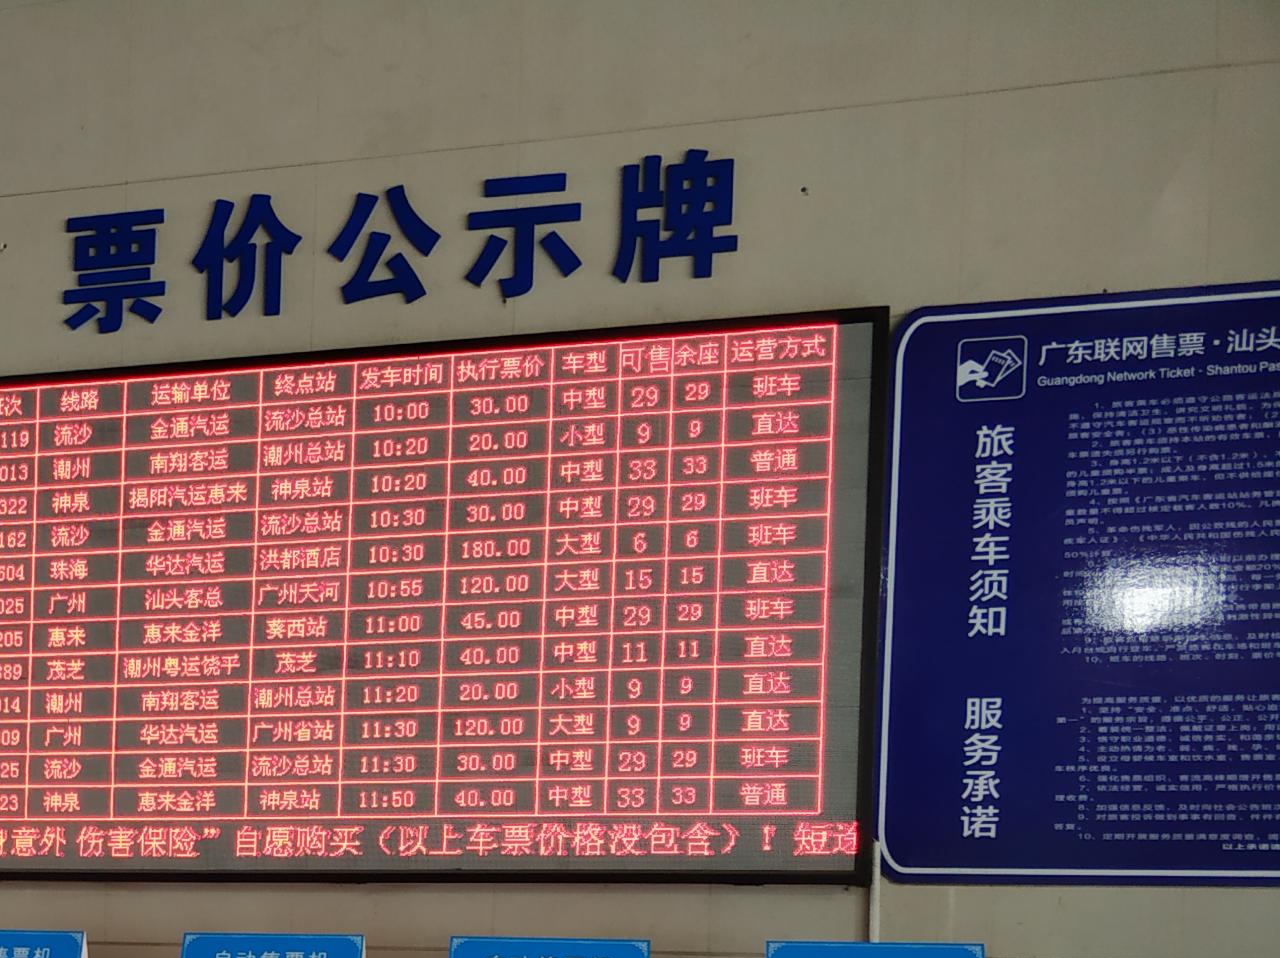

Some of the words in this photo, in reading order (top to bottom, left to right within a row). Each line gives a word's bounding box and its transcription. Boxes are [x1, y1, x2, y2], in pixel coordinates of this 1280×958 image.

[63, 148, 738, 334] 票价公示牌
[61, 388, 99, 412] 线路
[151, 379, 230, 405] 运输单位
[274, 370, 336, 396] 终点站
[359, 363, 442, 389] 发车时间
[456, 355, 544, 382] 执行票价
[562, 350, 607, 374] 车型
[623, 344, 671, 372] 可售
[675, 342, 719, 366] 余座
[731, 334, 826, 363] 运营方式
[1037, 374, 1105, 387] Guangdong
[1107, 369, 1156, 383] Network
[1159, 366, 1196, 379] Ticket
[1206, 363, 1258, 376] Shantou
[54, 423, 92, 446] 流沙
[151, 413, 229, 440] 金通汽运
[264, 405, 346, 431] 流沙总站
[375, 401, 429, 422] 10:00
[471, 395, 528, 415] 30.00
[562, 386, 606, 410] 中型
[632, 385, 659, 408] 29
[685, 382, 710, 401] 29
[753, 373, 801, 398] 班车
[52, 490, 90, 513] 神泉
[129, 481, 247, 508] 揭阳汽运惠来
[272, 476, 333, 500] 神泉站
[372, 473, 427, 493] 10:20
[467, 467, 526, 486] 40.00
[560, 458, 603, 482] 中型
[629, 458, 656, 480] 33
[683, 456, 707, 474] 33
[750, 446, 798, 472] 普通
[50, 558, 88, 580] 珠海
[146, 551, 224, 576] 华达汽运
[260, 546, 341, 570] 洪都酒店
[370, 544, 424, 563] 10:30
[462, 538, 530, 558] 180.00
[556, 532, 601, 555] 大型
[633, 533, 646, 553] 6
[686, 530, 698, 547] 6
[748, 522, 796, 546] 班车
[967, 424, 1016, 638] 旅客乘车须知
[49, 592, 86, 614] 广州
[145, 586, 223, 610] 汕头客总
[258, 581, 340, 605] 广州天河
[368, 579, 422, 598] 10:55
[461, 575, 529, 594] 120.00
[555, 568, 599, 591] 大型
[625, 569, 652, 590] 15
[681, 566, 703, 584] 15
[747, 560, 794, 584] 直达
[48, 625, 85, 647] 惠来
[143, 620, 222, 644] 惠来金洋
[266, 616, 328, 639] 葵西站
[366, 614, 421, 633] 11:00
[461, 611, 520, 629] 45.00
[556, 604, 598, 627] 中型
[624, 606, 650, 626] 29
[678, 604, 702, 621] 29
[745, 597, 793, 620] 班车
[47, 659, 85, 680] 茂芝
[123, 654, 240, 678] 潮州粤运饶平
[275, 650, 317, 673] 茂芝
[365, 649, 420, 668] 11:10
[460, 646, 519, 665] 40.00
[554, 640, 597, 663] 中型
[622, 642, 647, 663] 11
[679, 640, 698, 657] 11
[744, 634, 792, 657] 直达
[43, 789, 80, 812] 神泉
[138, 790, 215, 811] 惠来金洋
[260, 789, 320, 810] 神泉站
[360, 790, 415, 808] 11:50
[455, 790, 514, 806] 40.00
[549, 785, 592, 807] 中型
[618, 788, 644, 807] 33
[672, 787, 695, 804] 33
[740, 781, 787, 806] 普通
[960, 697, 1003, 838] 服务承诺
